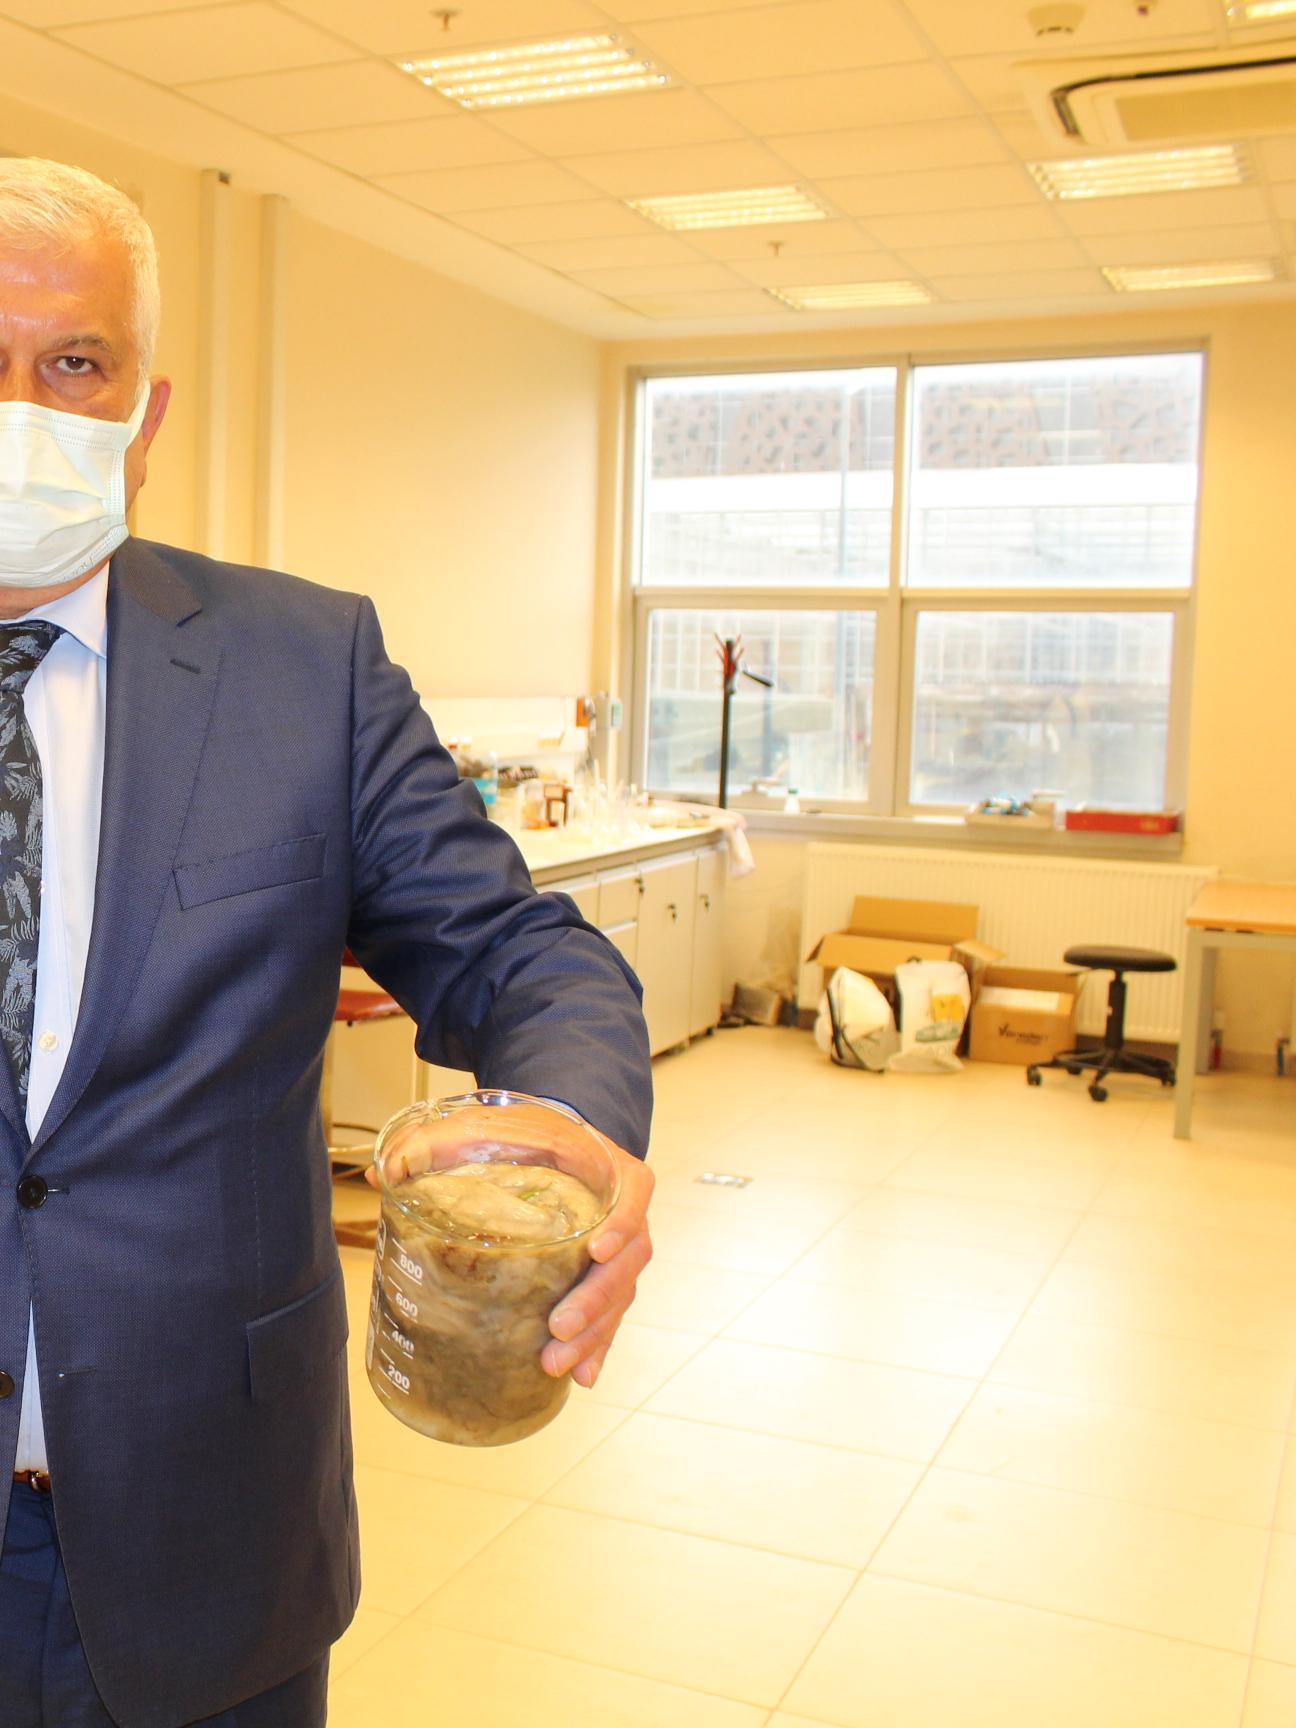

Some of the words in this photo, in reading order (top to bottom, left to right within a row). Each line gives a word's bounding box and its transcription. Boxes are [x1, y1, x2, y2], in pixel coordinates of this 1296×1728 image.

[399, 1254, 424, 1280] 800
[395, 1292, 418, 1317] 600
[391, 1330, 415, 1354] 400
[388, 1365, 411, 1390] 200
